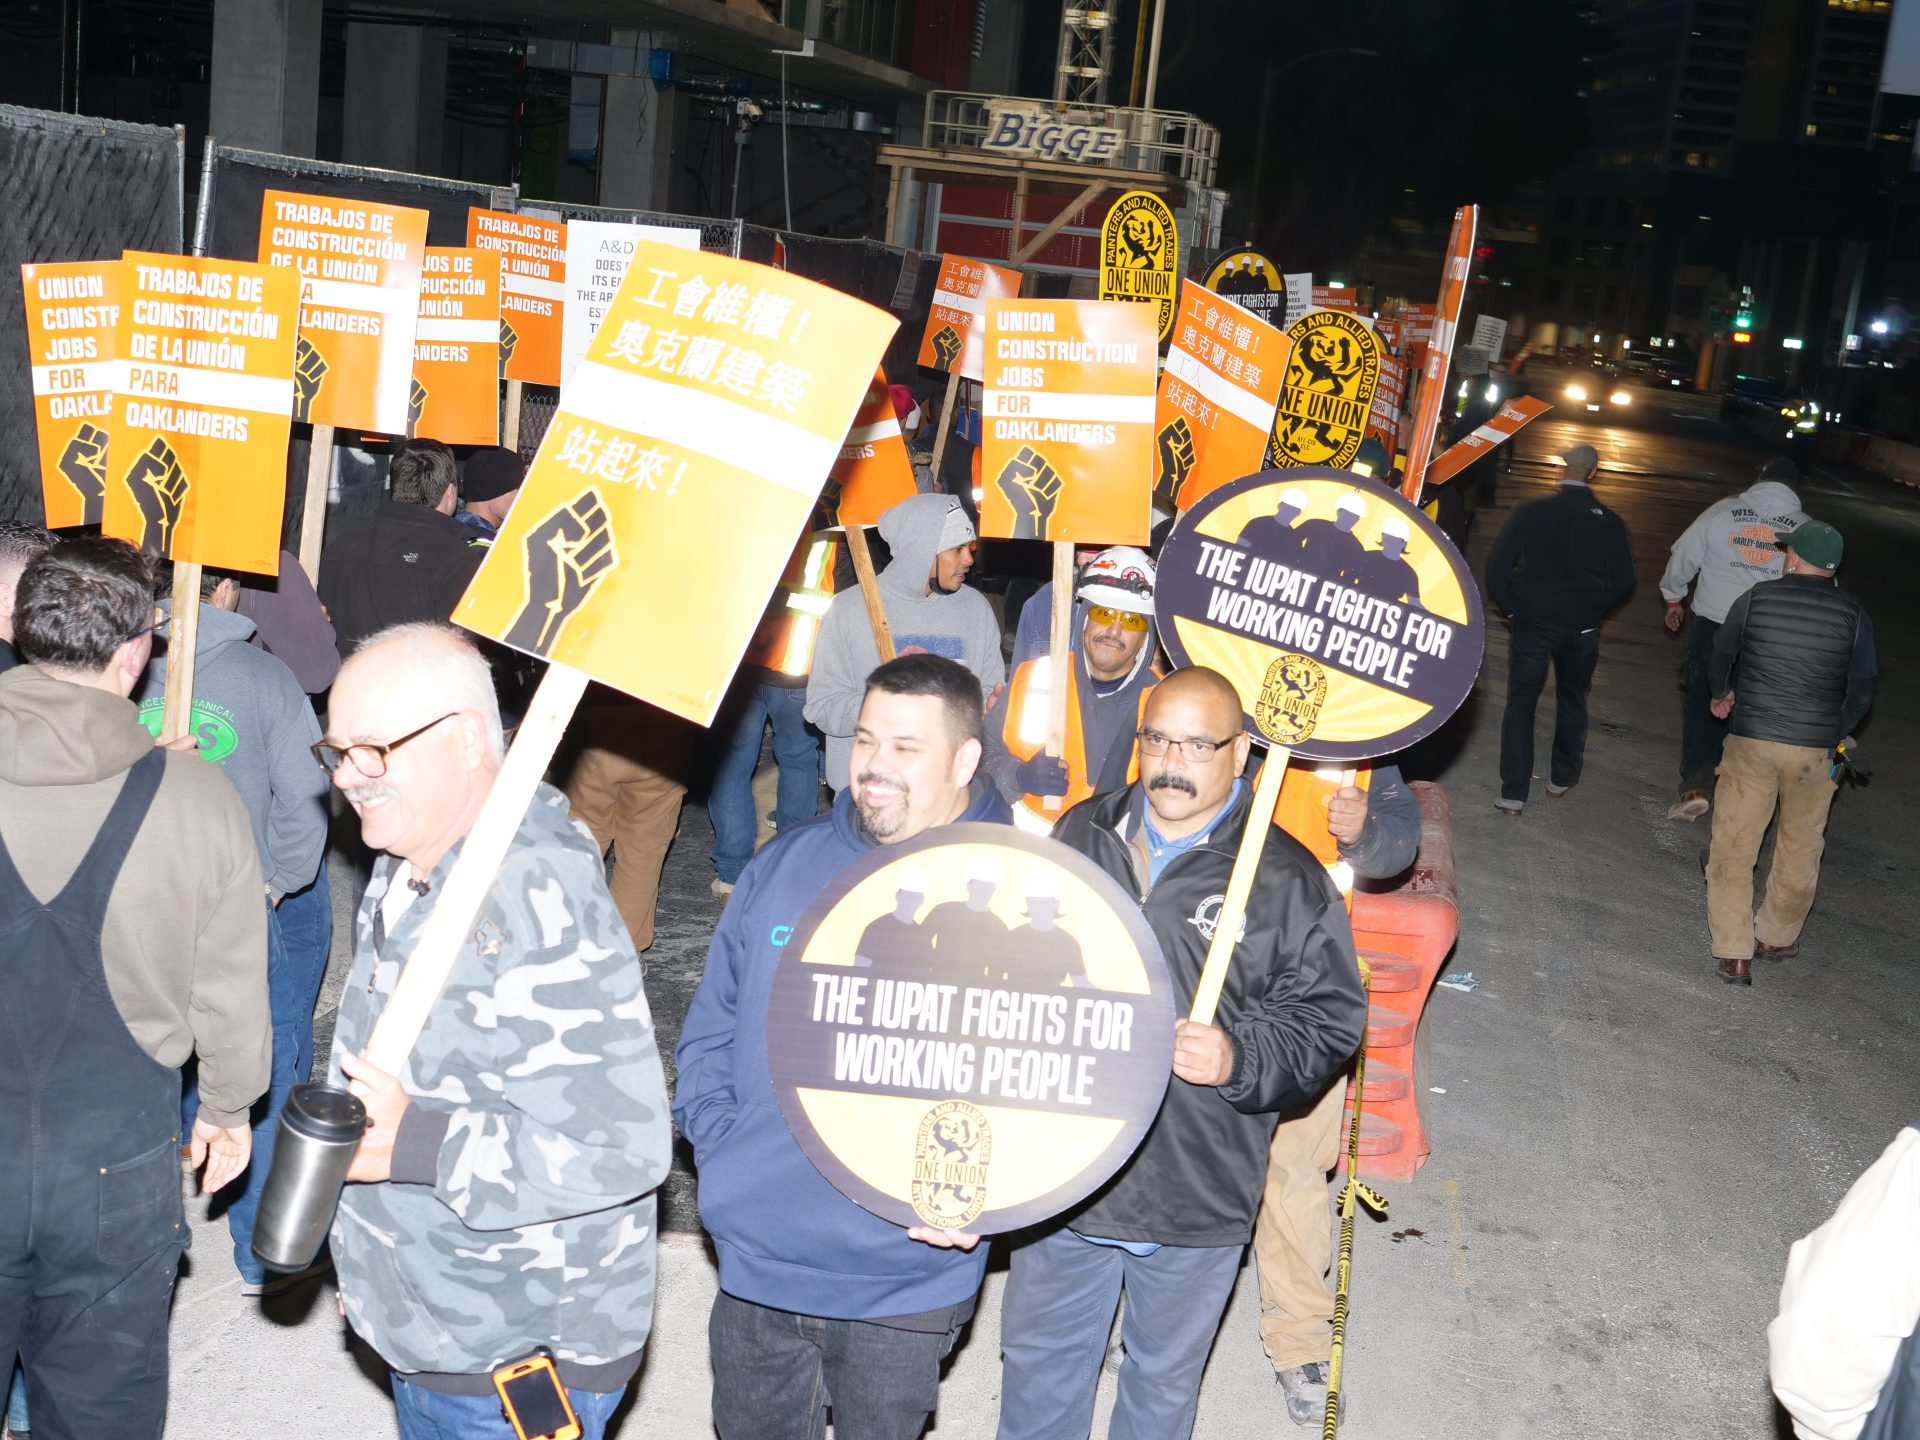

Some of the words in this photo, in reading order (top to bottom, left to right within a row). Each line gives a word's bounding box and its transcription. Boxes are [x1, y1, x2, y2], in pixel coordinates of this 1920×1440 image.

[990, 113, 1119, 157] BIGGE
[275, 201, 366, 230] TRABAJOS
[370, 213, 394, 234] DE
[477, 215, 541, 240] TRABAJOS
[544, 228, 559, 244] DE
[272, 227, 407, 261] CONSTRUCCIÓN
[600, 240, 634, 254] A&D
[1107, 210, 1123, 263] PAINTERS
[1122, 197, 1140, 214] AND
[1141, 198, 1169, 225] ALLIED
[1164, 226, 1174, 269] TRADES
[476, 234, 567, 264] CONSTRUCCIÓN
[296, 255, 318, 276] LA
[322, 258, 378, 283] UNIÓN
[454, 256, 473, 273] DE
[512, 258, 550, 279] UNIÓN
[596, 259, 622, 271] DOES
[38, 275, 104, 300] UNION
[136, 265, 233, 300] TRABAJOS
[237, 275, 264, 302] DE
[592, 275, 608, 287] ITS
[1107, 269, 1130, 292] ONE
[1134, 271, 1170, 296] UNION
[577, 290, 596, 302] THE
[1266, 293, 1279, 307] FOR
[133, 299, 279, 340] CONSTRUCCIÓN
[301, 308, 380, 336] LANDERS
[997, 312, 1055, 333] UNION
[45, 336, 97, 361] JOBS
[130, 333, 157, 358] DE
[161, 337, 183, 364] LA
[186, 338, 246, 370] UNIÓN
[997, 339, 1138, 364] CONSTRUCTION
[1181, 325, 1263, 390] 奧克蘭建築
[1308, 313, 1334, 328] AND
[1335, 315, 1372, 352] ALLIED
[1358, 350, 1377, 399] TRADES
[49, 368, 86, 390] FOR
[606, 319, 812, 413] 奧克蘭建築
[996, 367, 1044, 388] JOBS
[1173, 354, 1201, 389] 工人
[130, 368, 178, 395] PARA
[997, 395, 1031, 414] FOR
[1165, 380, 1220, 430] 站起來！
[1279, 387, 1304, 413] NE
[1307, 393, 1366, 430] UNION
[125, 402, 249, 442] OAKLANDERS
[995, 421, 1116, 445] OAKLANDERS
[556, 424, 688, 496] 站起來！
[1731, 508, 1798, 528] WISSIN
[1196, 541, 1246, 586] THE
[1243, 557, 1318, 608] IUPAT
[1315, 580, 1401, 640] FIGHTS
[1401, 612, 1452, 660] FOR
[1207, 586, 1324, 653] WORKING
[1323, 624, 1418, 689] PEOPLE
[1261, 689, 1282, 706] ONE
[1285, 696, 1319, 720] UNION
[1315, 679, 1327, 706] TRADES
[812, 973, 868, 1025] THE
[872, 979, 958, 1033] IUPAT
[961, 987, 1067, 1045] FIGHTS
[1072, 998, 1134, 1052] FOR
[835, 1032, 975, 1093] WORKING
[980, 1046, 1096, 1106] PEOPLE
[935, 1102, 955, 1118] AND
[915, 1160, 941, 1180] ONE
[945, 1163, 987, 1185] UNION
[964, 1189, 986, 1222] UNION
